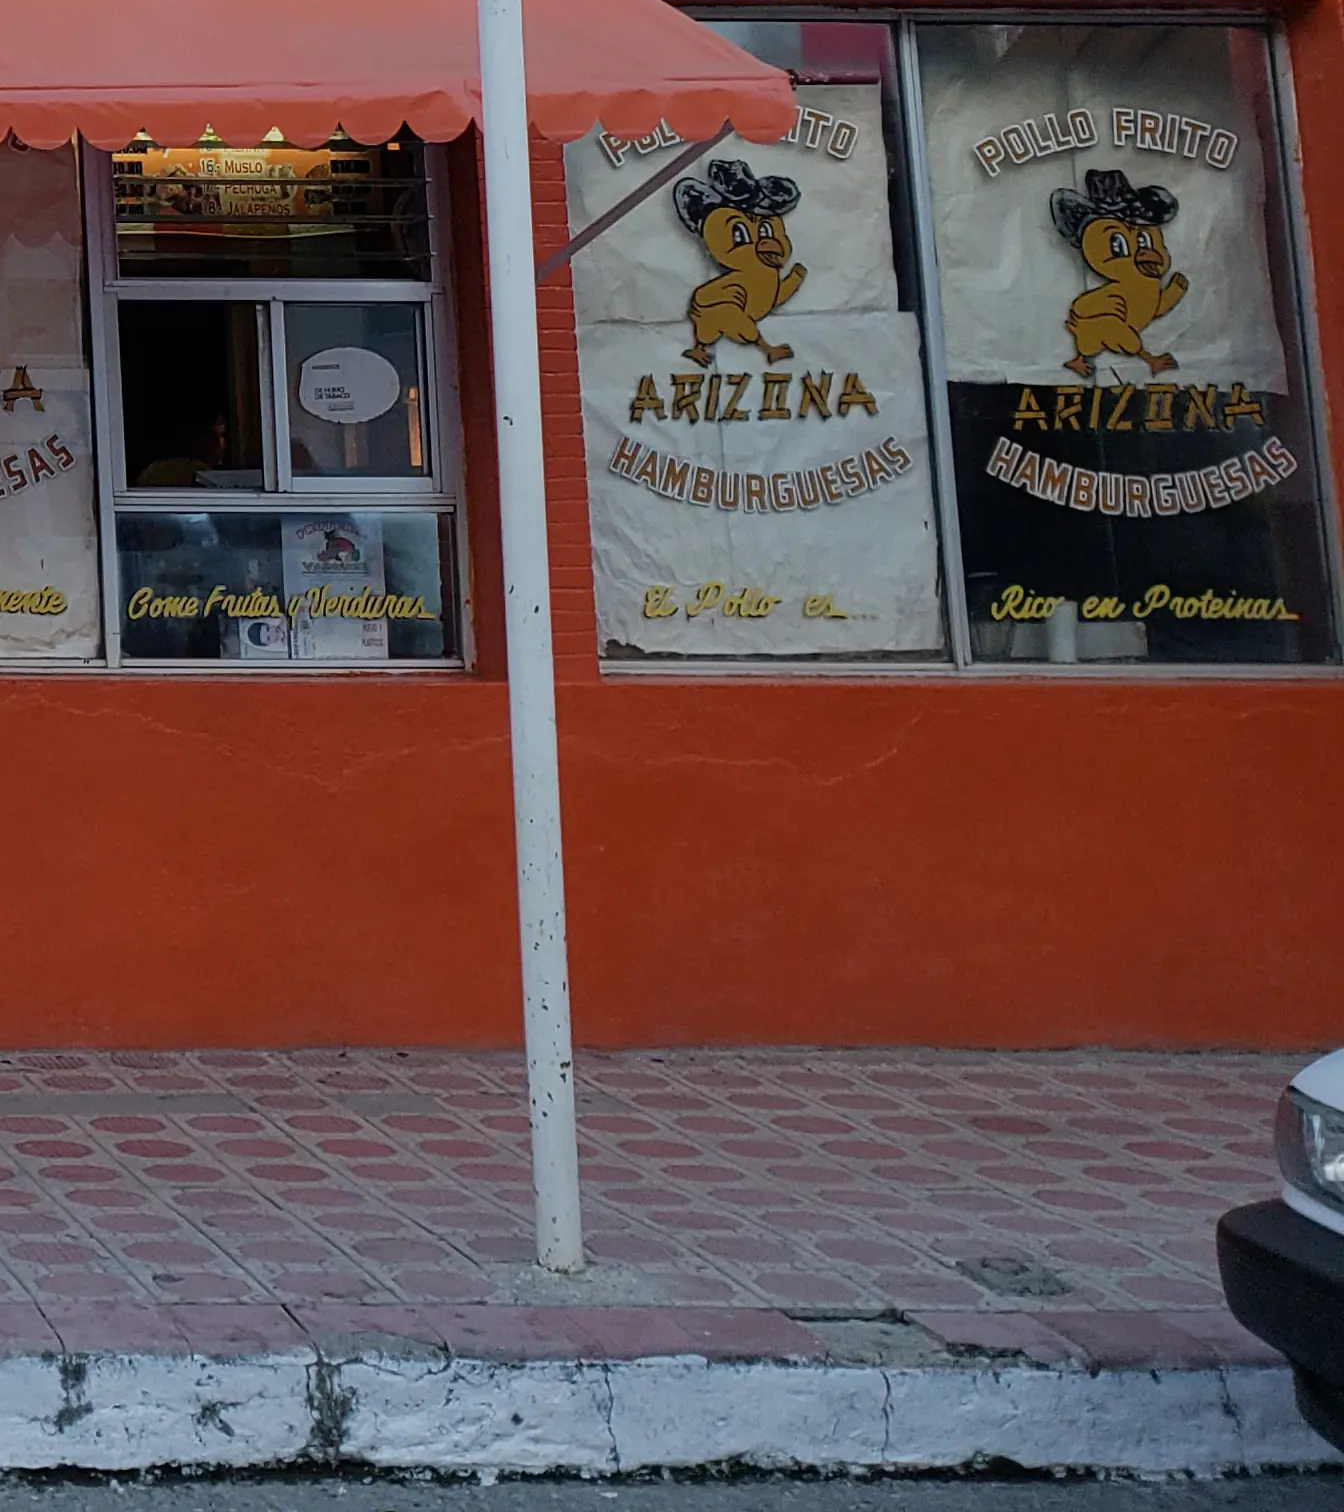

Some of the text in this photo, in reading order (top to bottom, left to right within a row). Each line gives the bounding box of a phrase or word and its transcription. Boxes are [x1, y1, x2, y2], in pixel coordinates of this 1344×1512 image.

[974, 106, 1239, 178] POLLO FRITO
[224, 160, 263, 174] MUSLO
[224, 183, 277, 194] PECHUGA
[629, 371, 880, 424] ARIZONA
[1011, 384, 1266, 433] ARIZONA
[608, 436, 914, 515] HAMBURGUESAS
[985, 435, 1299, 520] HAMBURGUESAS
[128, 587, 200, 622] Come
[204, 585, 286, 619] Frutas
[304, 584, 435, 622] Verduras
[643, 587, 676, 619] El
[691, 583, 782, 620] Pollo
[991, 584, 1301, 623] Rico en Proteinas
